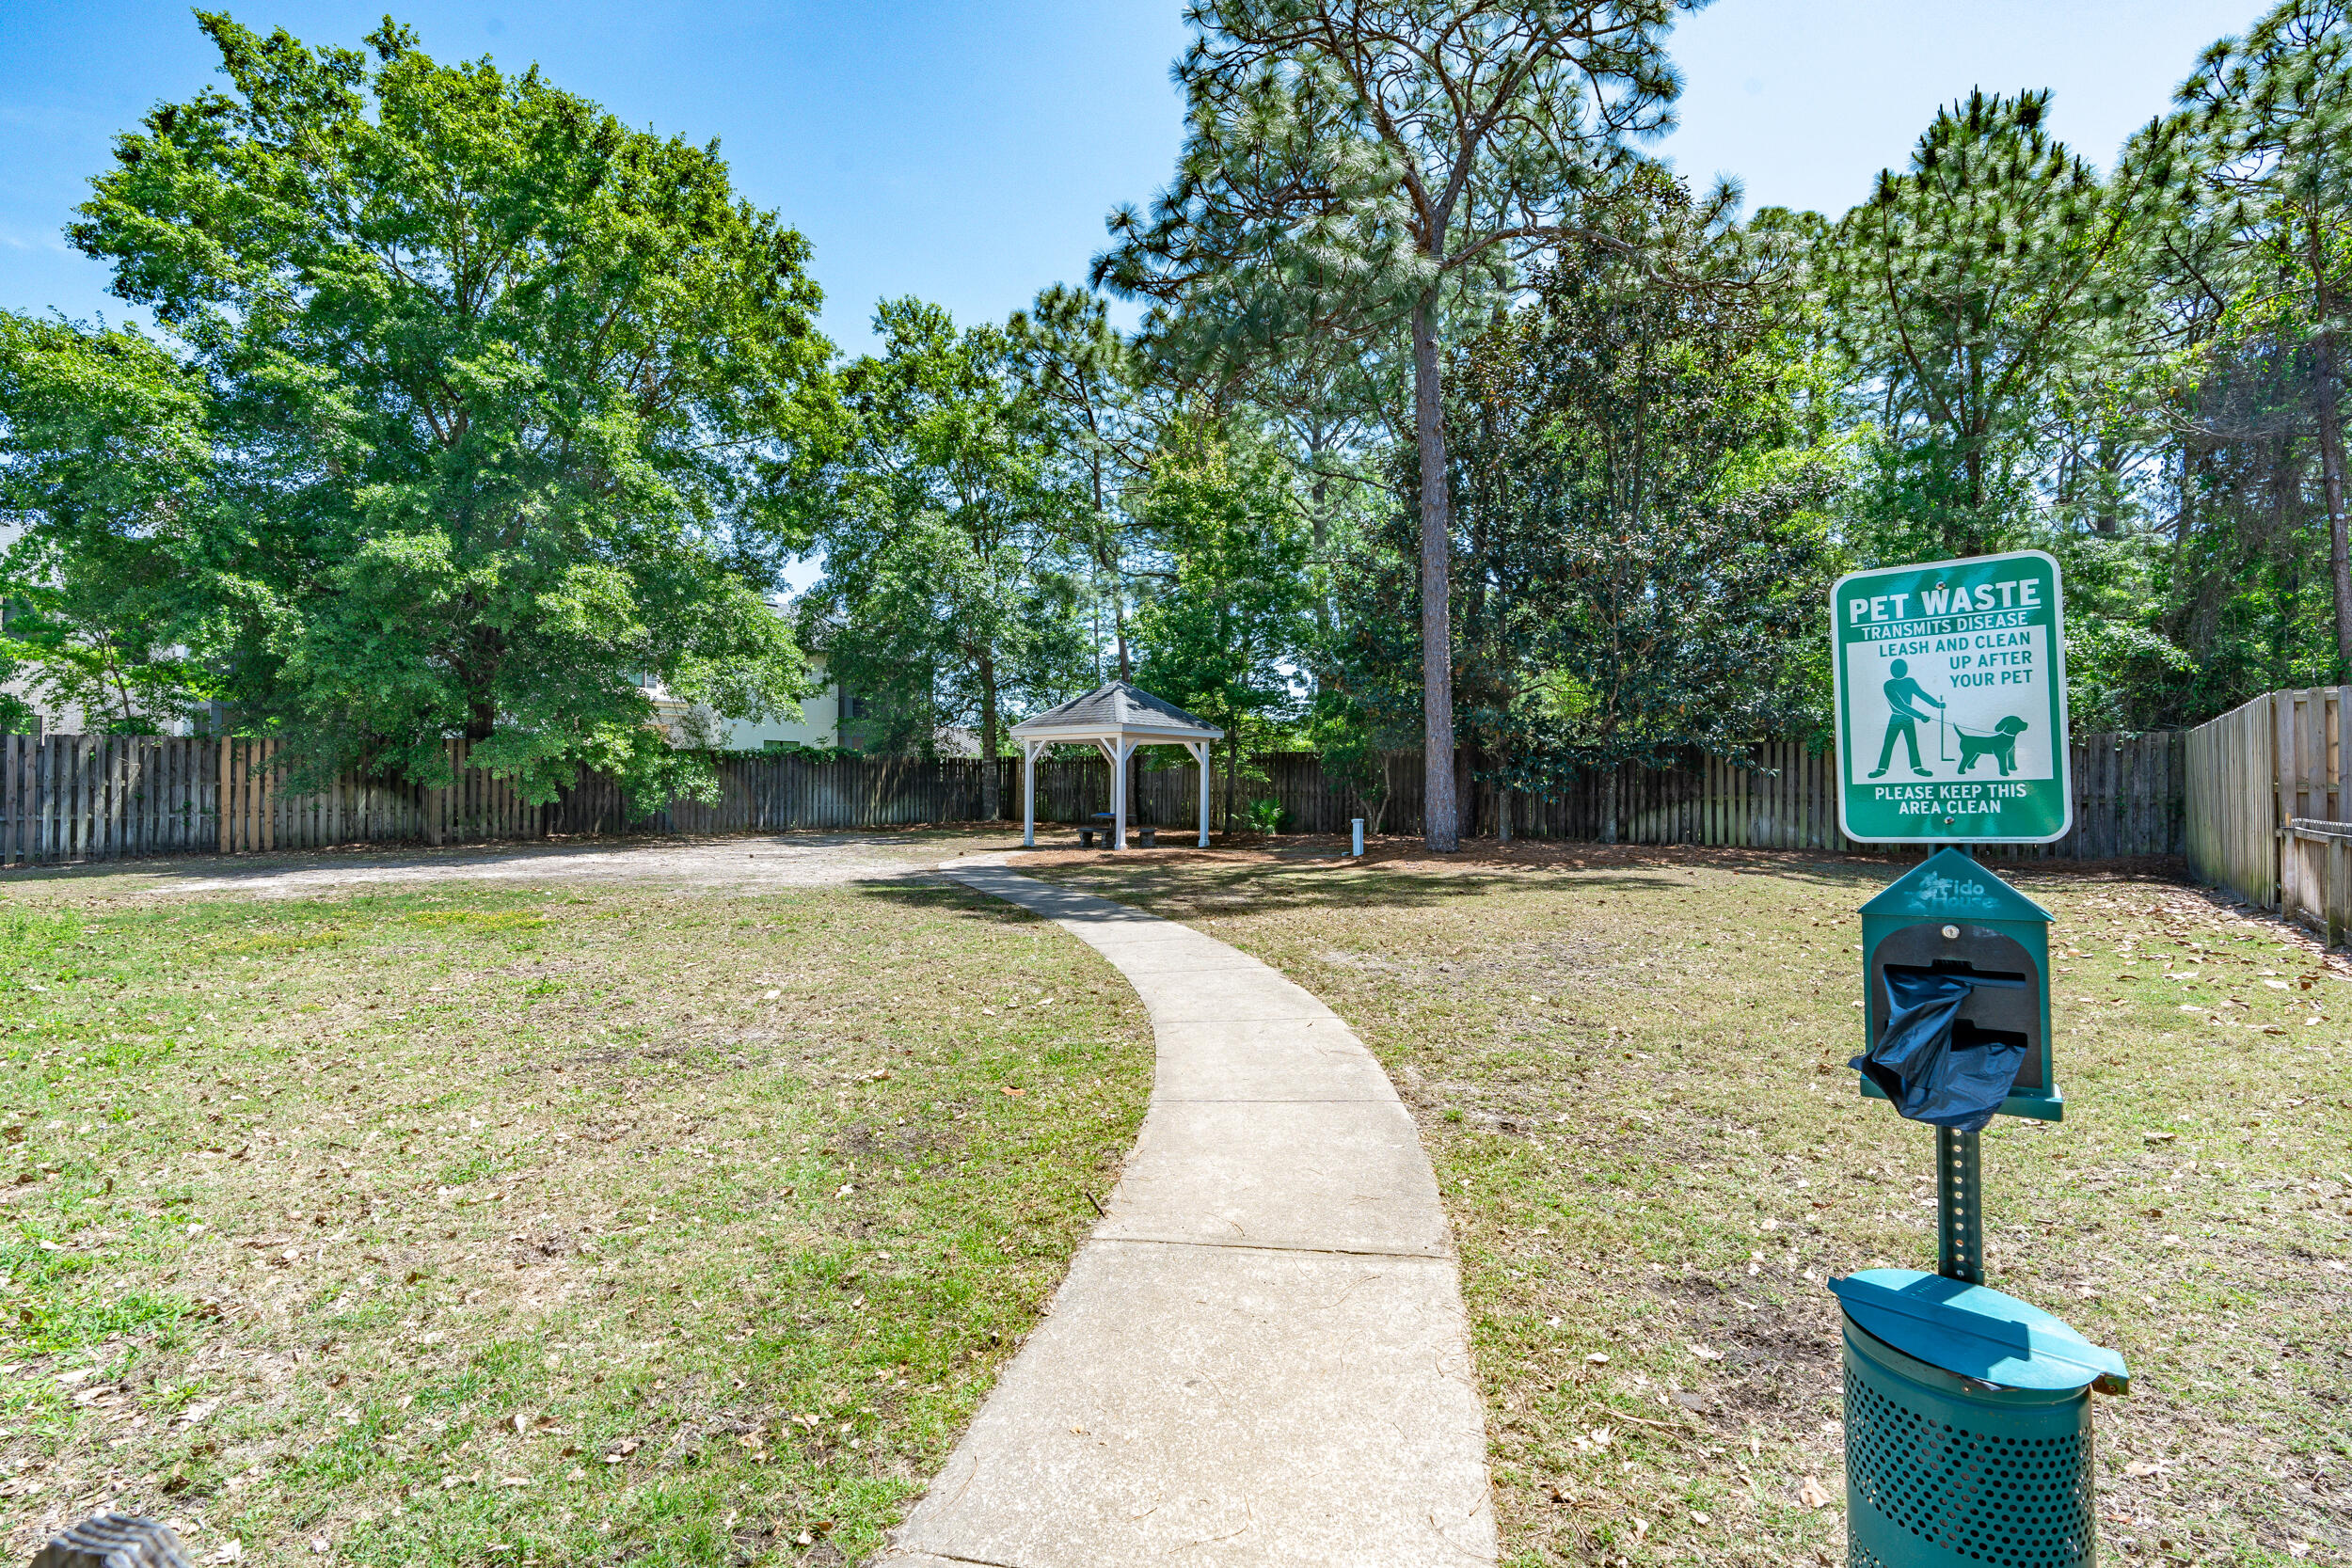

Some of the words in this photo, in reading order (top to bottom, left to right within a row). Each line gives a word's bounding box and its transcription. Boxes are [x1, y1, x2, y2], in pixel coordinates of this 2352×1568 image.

[1850, 594, 1909, 624] PET
[1921, 578, 2041, 616] WASTE
[1862, 620, 1950, 641] TRANSMITS
[1957, 611, 2027, 631] DISEASE
[1880, 639, 1929, 657] LEASH
[1936, 636, 1968, 652] AND
[1976, 632, 2030, 649] CLEAN
[1949, 654, 1971, 670] UP
[1978, 651, 2032, 667] AFTER
[1949, 673, 1994, 689] YOUR
[2002, 669, 2033, 685] PET
[1876, 785, 1933, 800] PLEASE
[1940, 784, 1982, 799] KEEP
[1987, 784, 2026, 798] THIS
[1899, 800, 1941, 815] AREA
[1947, 800, 2000, 814] CLEAN
